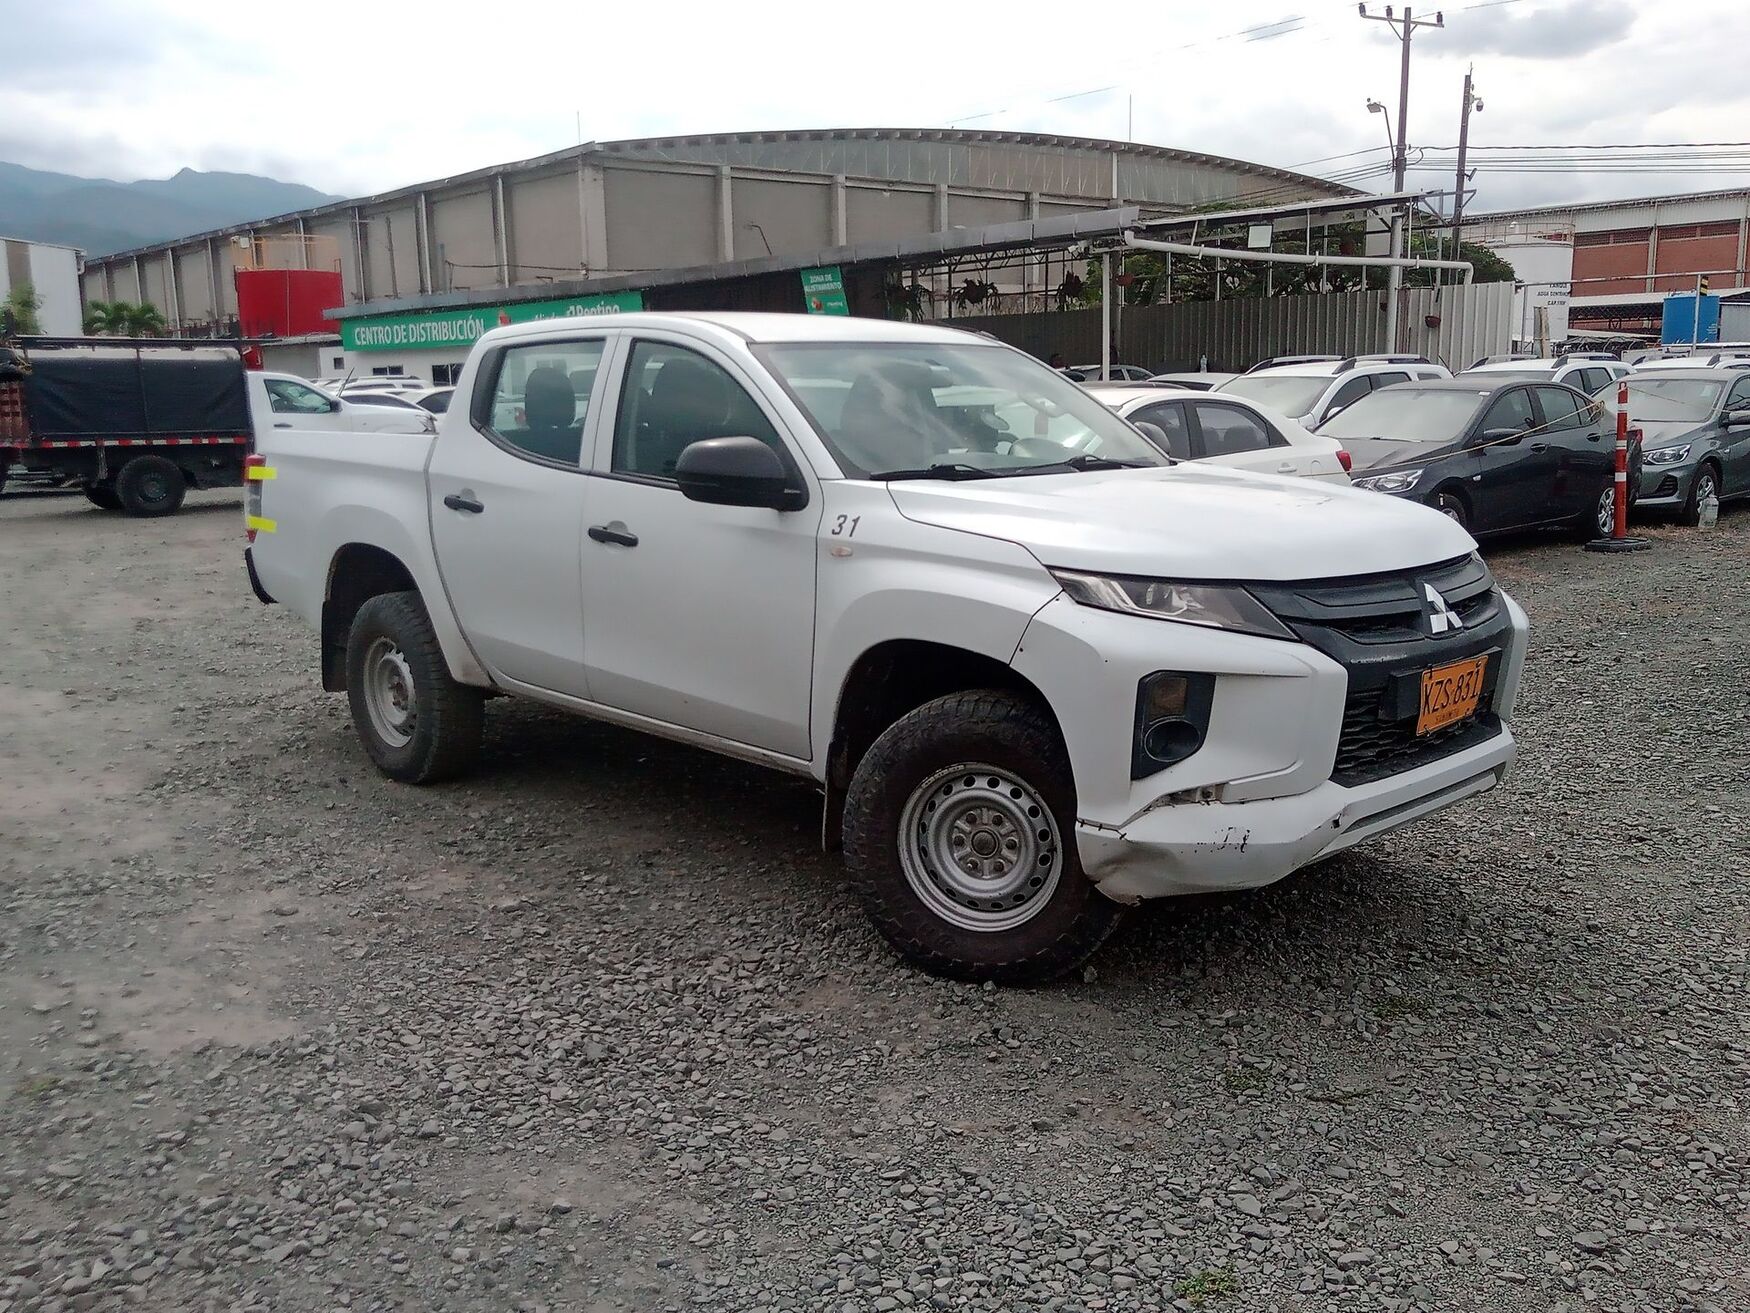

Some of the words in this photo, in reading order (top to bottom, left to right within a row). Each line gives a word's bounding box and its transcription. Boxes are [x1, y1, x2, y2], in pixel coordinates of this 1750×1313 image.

[354, 326, 392, 346] CENTRO
[393, 325, 408, 344] DE
[409, 314, 485, 343] DISTRIBUCIÓN
[831, 514, 861, 538] 31
